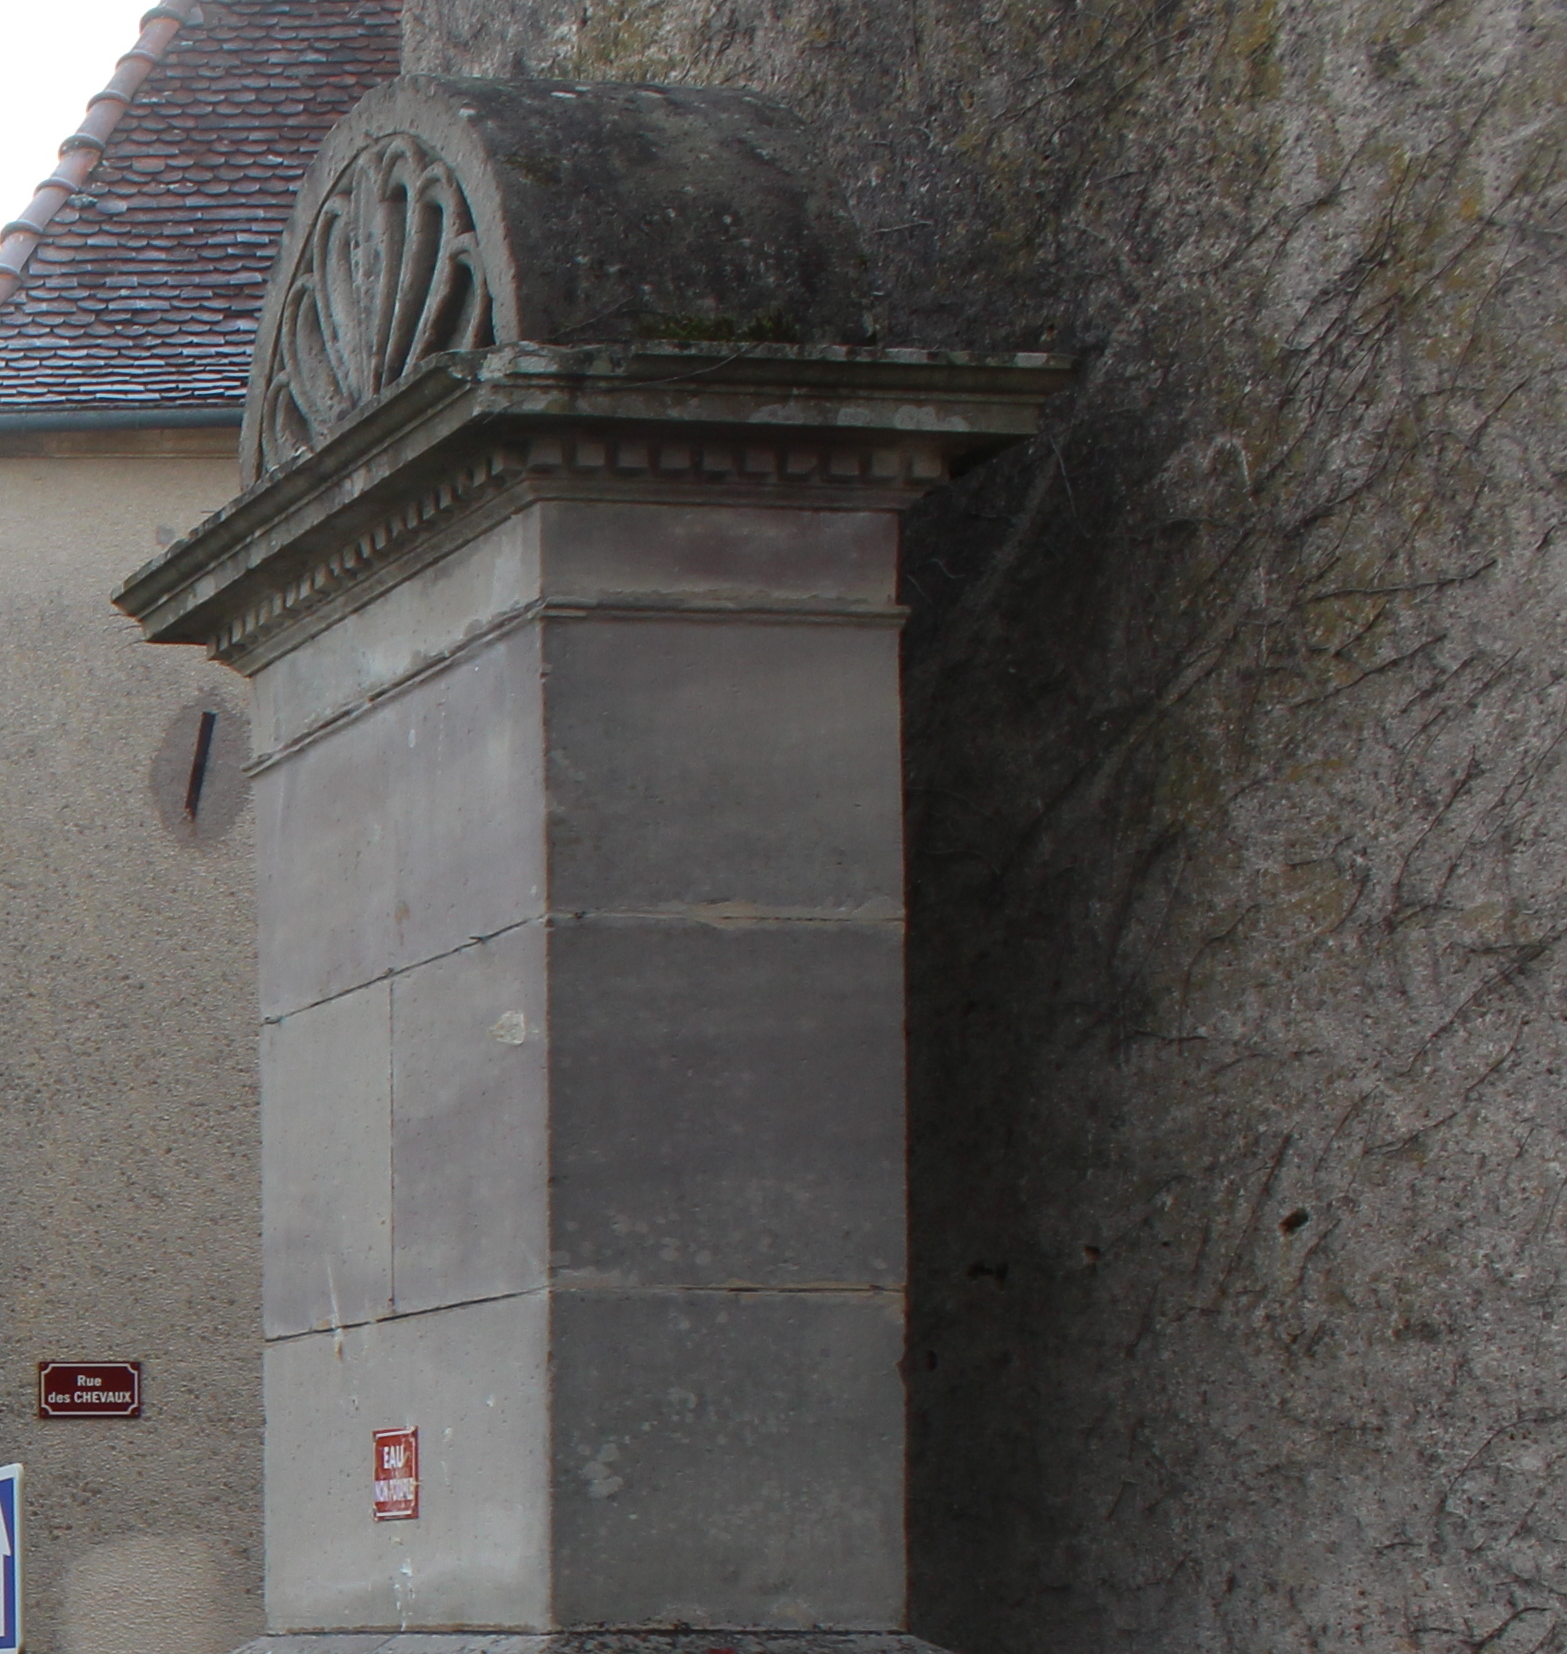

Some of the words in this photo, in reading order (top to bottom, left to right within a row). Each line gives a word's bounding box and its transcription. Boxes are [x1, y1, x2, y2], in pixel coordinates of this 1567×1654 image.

[77, 1375, 102, 1386] Rue
[48, 1392, 71, 1403] des
[74, 1391, 131, 1403] CHEVAUX
[383, 1445, 404, 1469] EAU
